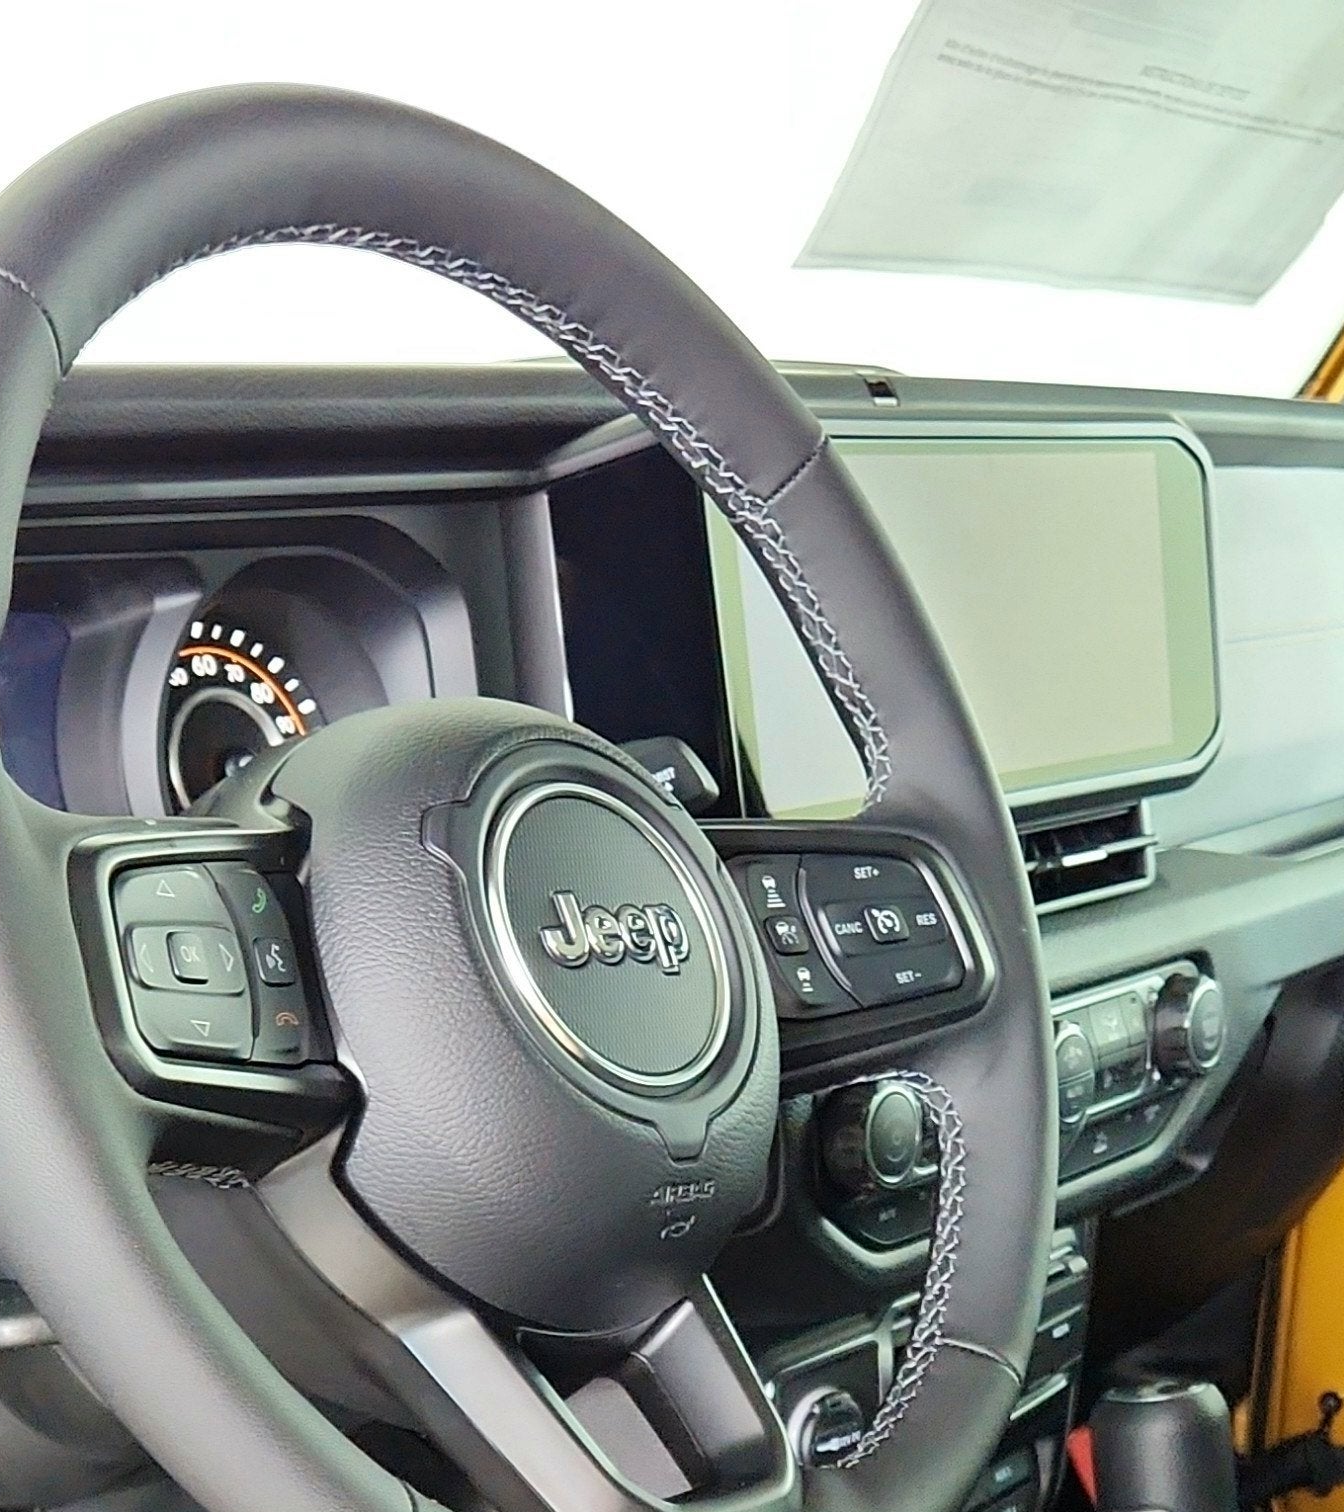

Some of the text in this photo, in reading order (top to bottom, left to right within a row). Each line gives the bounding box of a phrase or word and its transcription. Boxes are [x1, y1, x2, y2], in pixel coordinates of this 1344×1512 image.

[853, 866, 880, 880] SET+
[915, 912, 938, 926] RES
[539, 890, 690, 976] Jeep
[834, 921, 864, 936] CANC
[895, 970, 922, 985] SET-
